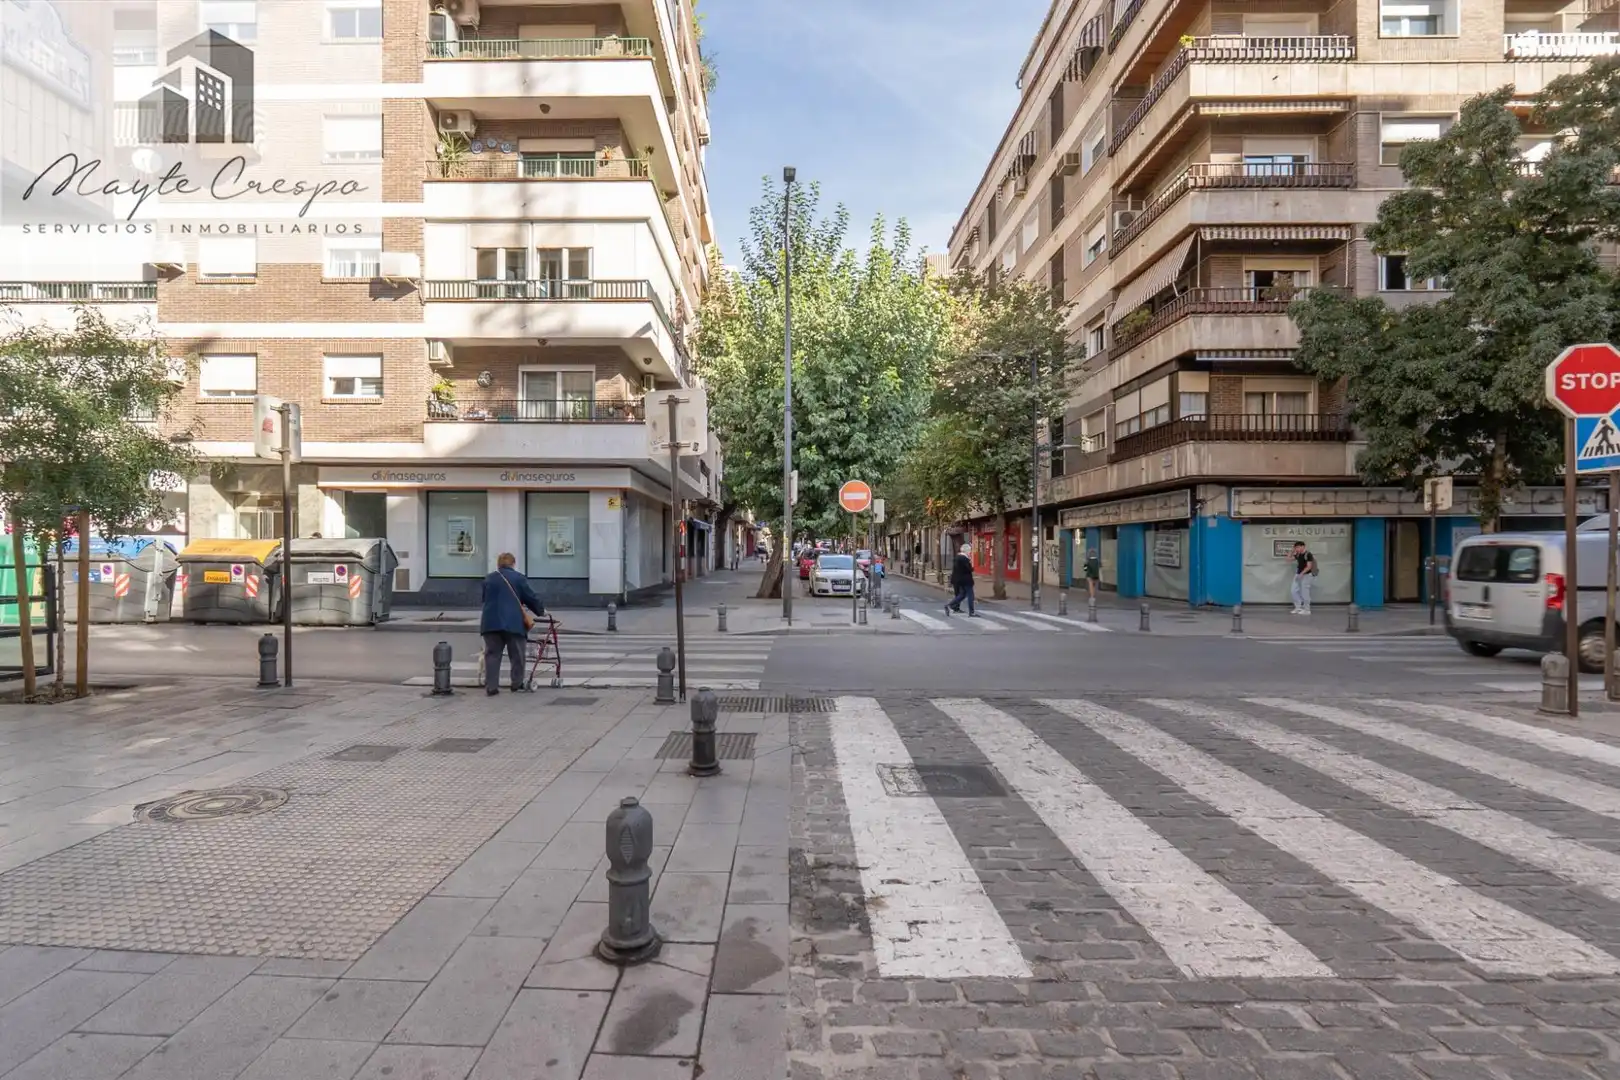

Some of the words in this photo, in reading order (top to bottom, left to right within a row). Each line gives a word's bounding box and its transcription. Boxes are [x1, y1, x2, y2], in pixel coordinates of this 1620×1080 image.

[1561, 372, 1620, 390] STOP
[371, 470, 447, 482] divinaseguros
[500, 470, 576, 483] divinaseguros
[1289, 527, 1346, 536] ALQUILA
